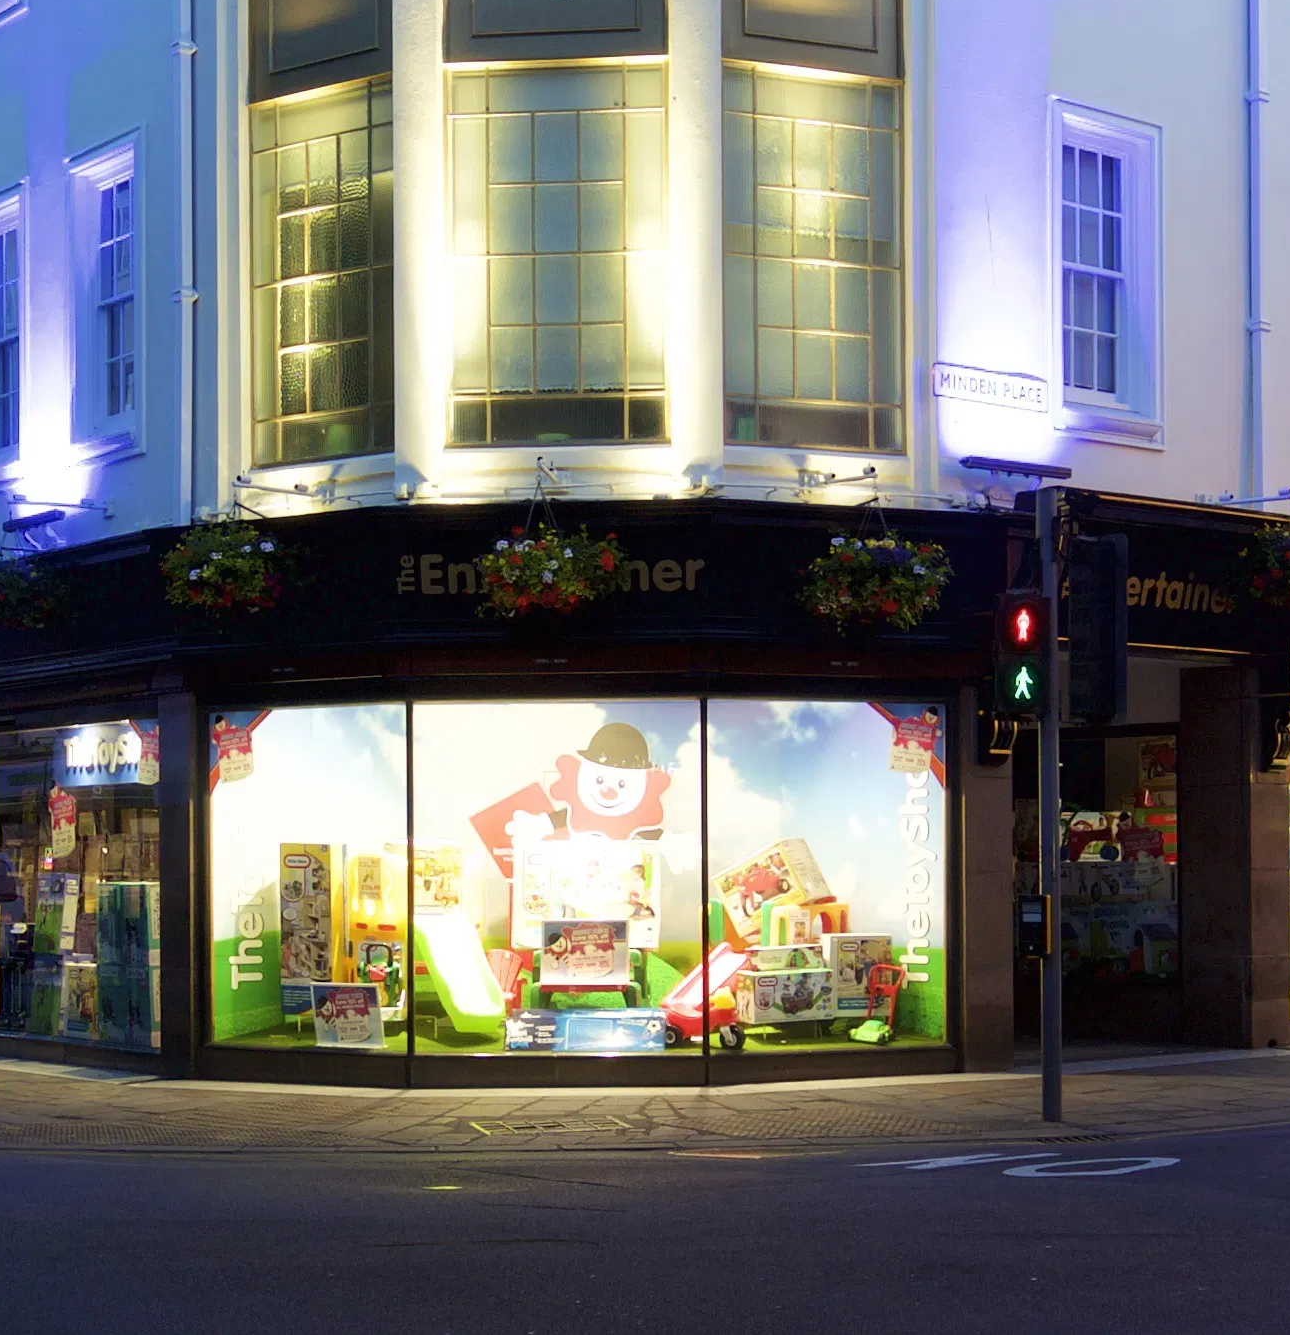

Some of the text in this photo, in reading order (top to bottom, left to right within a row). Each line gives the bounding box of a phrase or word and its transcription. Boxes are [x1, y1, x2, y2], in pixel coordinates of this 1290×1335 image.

[940, 371, 1043, 404] MINDEN PLACE
[396, 554, 415, 595] The
[853, 1152, 1182, 1177] NO
